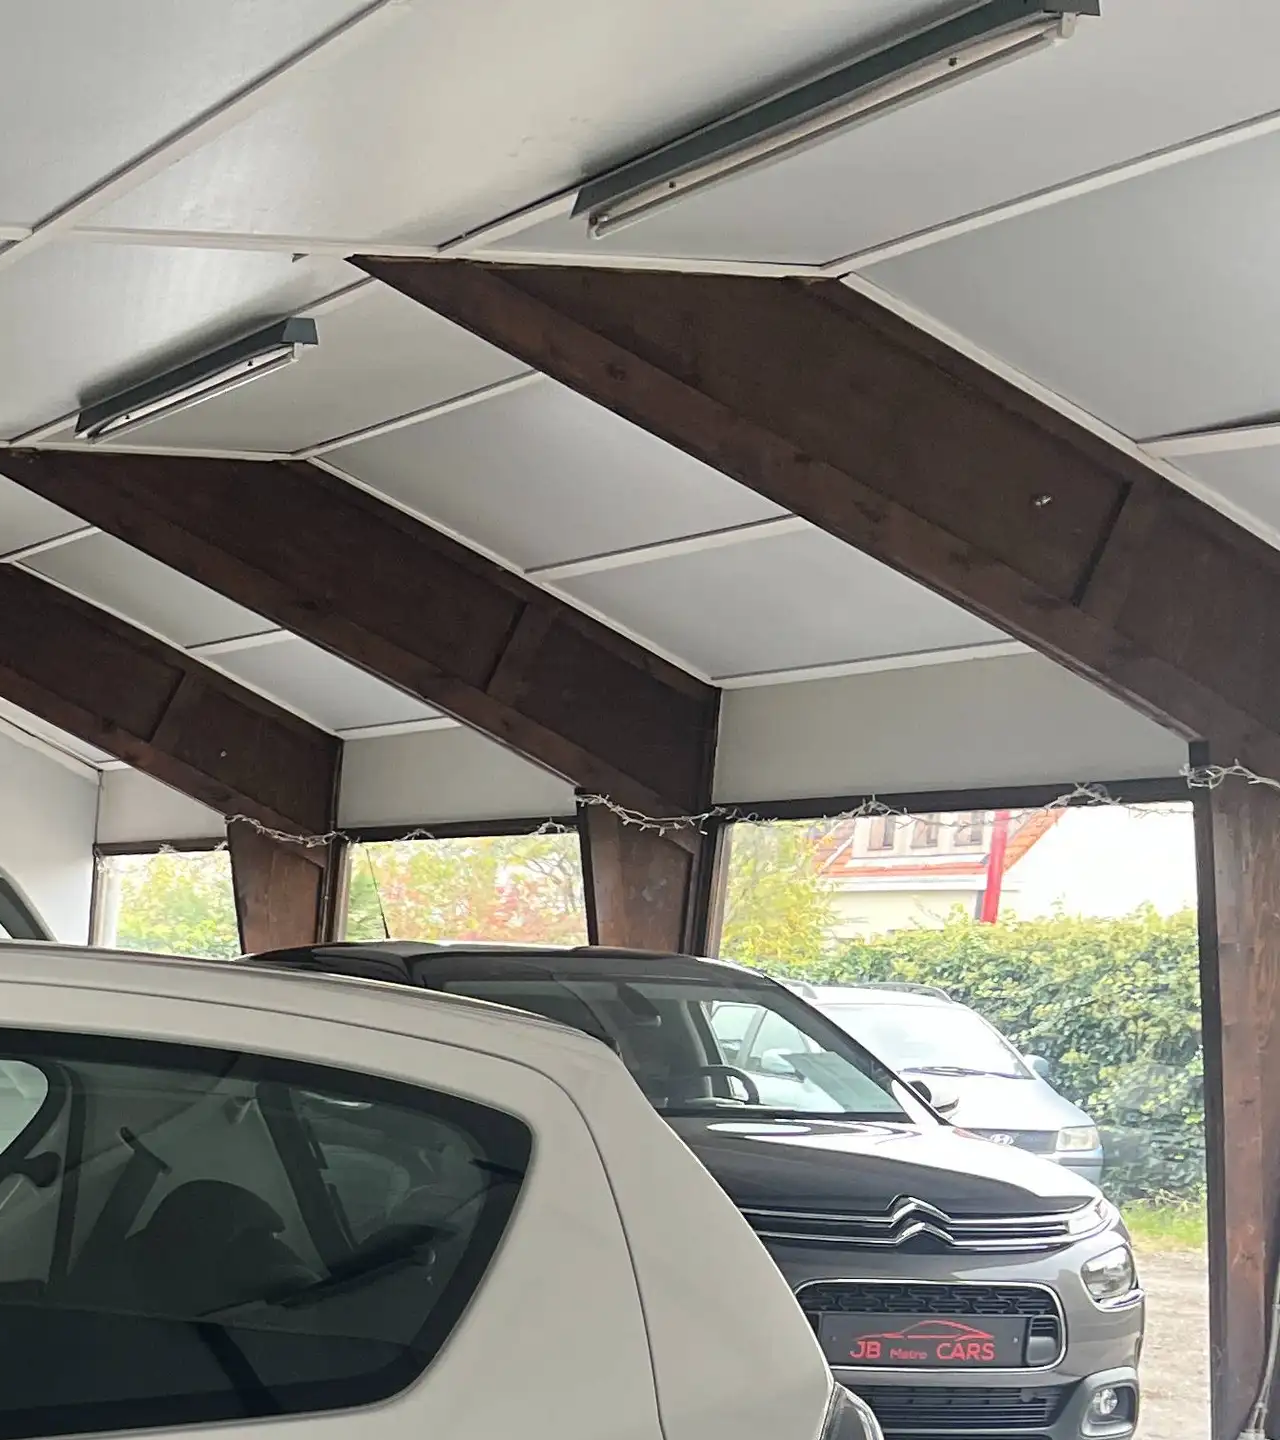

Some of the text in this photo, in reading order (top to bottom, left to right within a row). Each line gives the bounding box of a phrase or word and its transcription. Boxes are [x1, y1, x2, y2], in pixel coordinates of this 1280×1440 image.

[849, 1341, 996, 1361] JB Metro CARS
